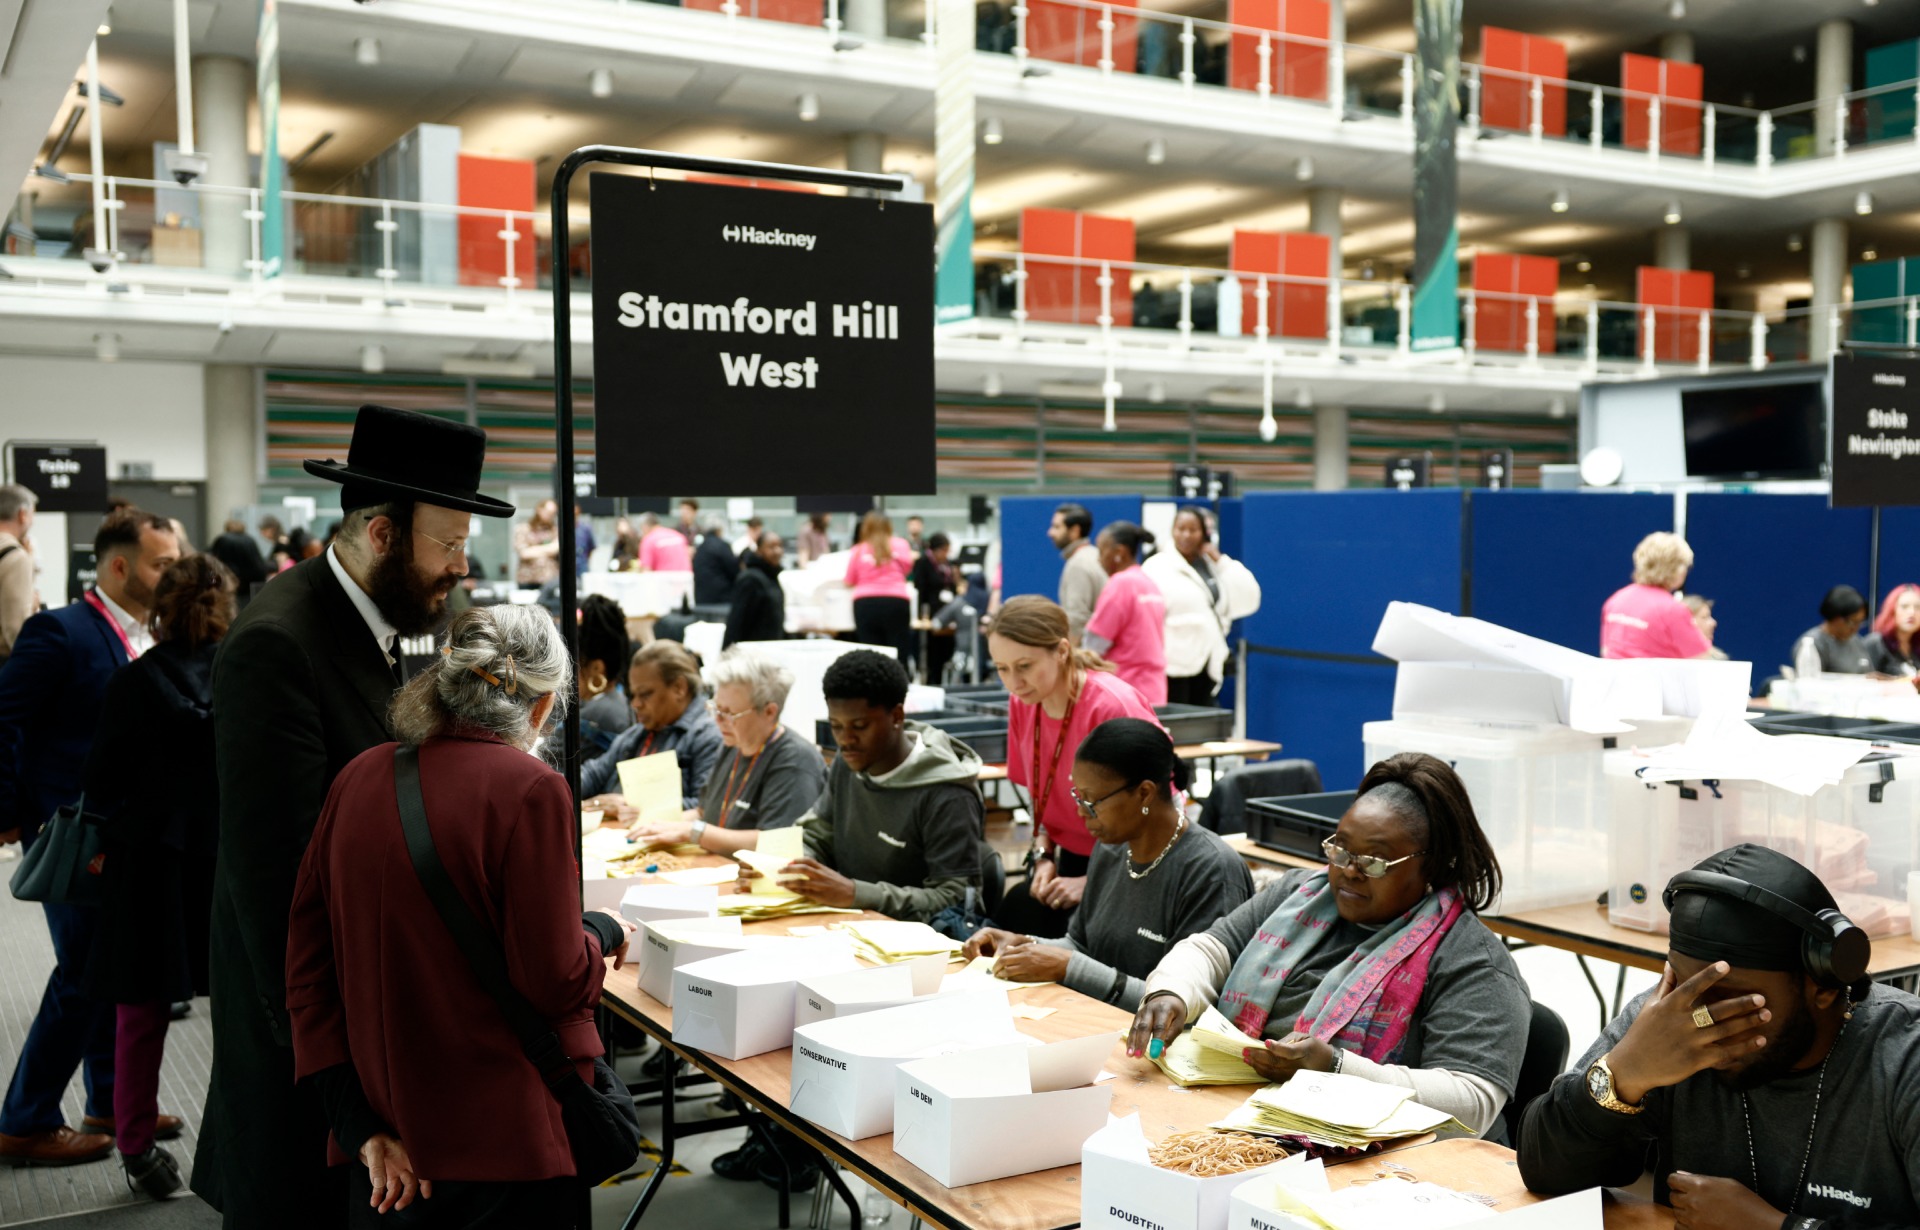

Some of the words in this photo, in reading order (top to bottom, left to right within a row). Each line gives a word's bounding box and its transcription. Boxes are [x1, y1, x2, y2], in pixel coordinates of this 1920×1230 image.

[742, 226, 816, 251] Hackney
[617, 291, 817, 336] Stamford
[832, 300, 899, 340] Hill
[719, 352, 819, 389] West
[1867, 408, 1908, 429] Stoke
[657, 941, 669, 952] VOTES
[688, 984, 713, 998] LABOUR
[808, 998, 822, 1012] GREEN
[800, 1046, 847, 1071] CONSERVATIVE
[910, 1086, 920, 1099] LIB
[920, 1092, 933, 1106] DEM
